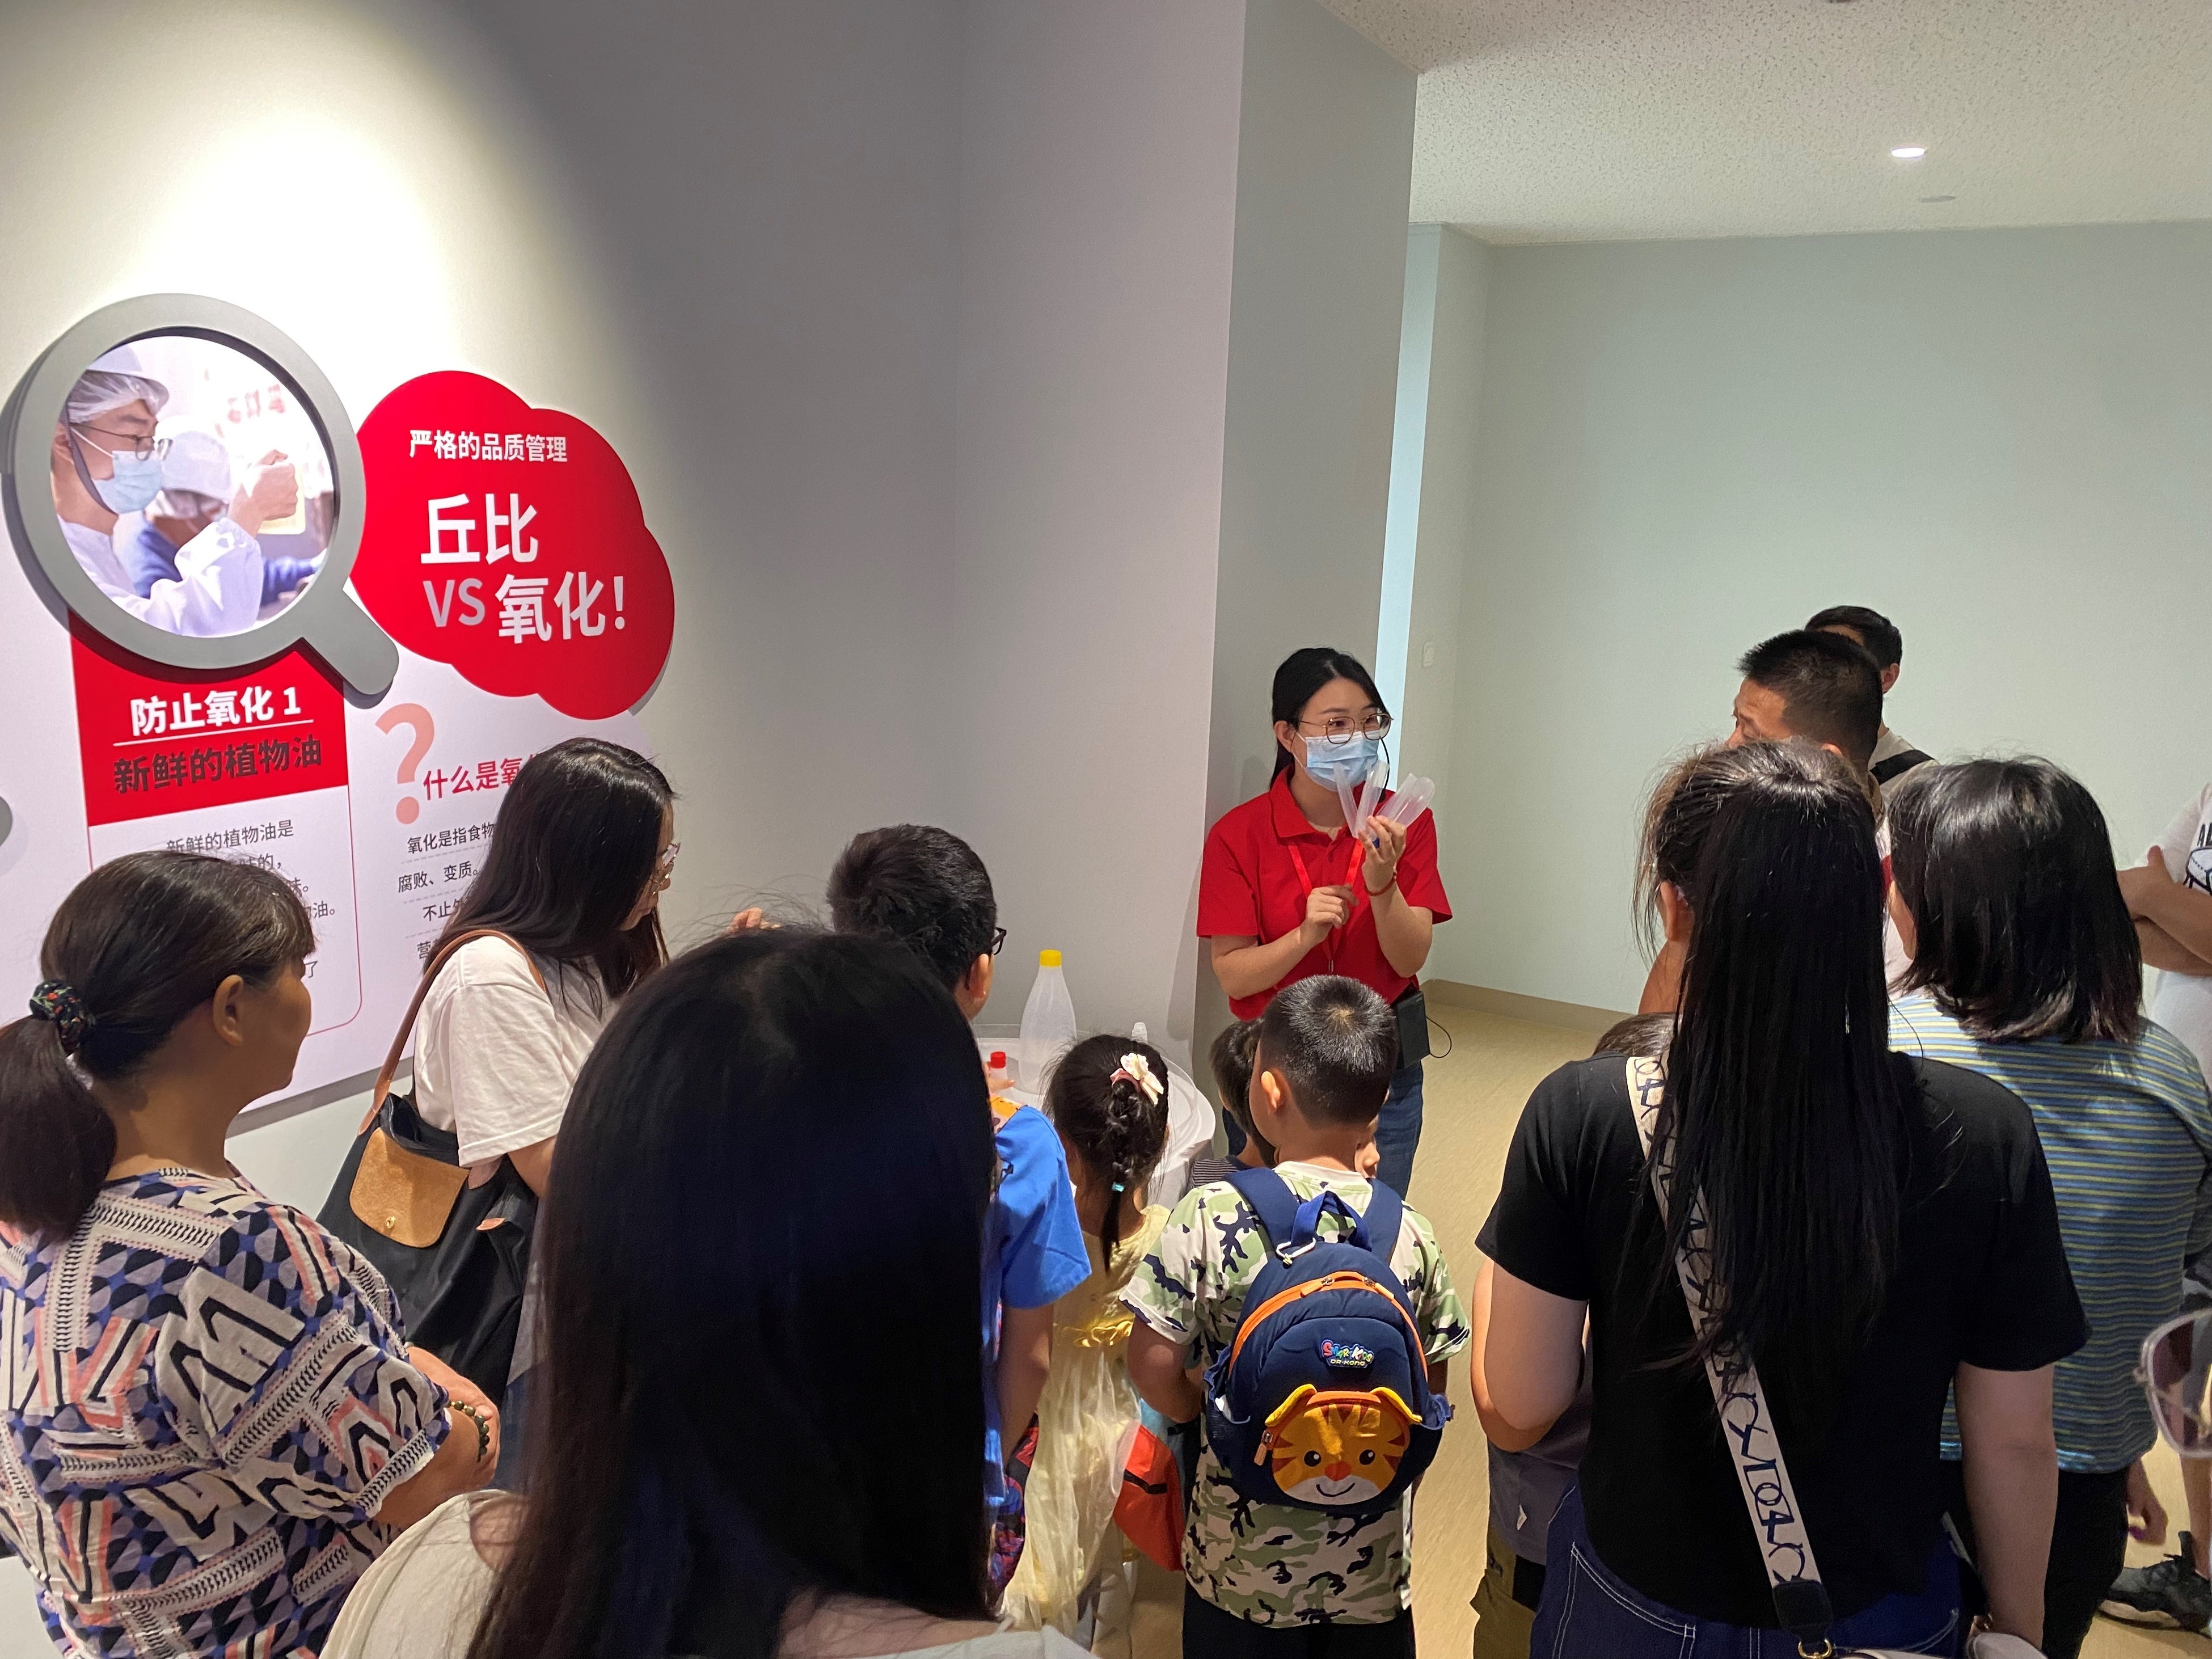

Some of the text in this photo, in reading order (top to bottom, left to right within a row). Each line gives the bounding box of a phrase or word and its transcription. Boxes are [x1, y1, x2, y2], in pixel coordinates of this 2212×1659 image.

[409, 429, 568, 462] 严格的品质管理
[420, 492, 538, 565] 丘比
[423, 577, 486, 628] VS
[130, 686, 301, 737] 防止氧化 1
[113, 734, 322, 794] 新鲜的植物油
[423, 754, 535, 801] 什么是氧
[407, 822, 494, 854] 氧化是指食物
[398, 860, 478, 893] 腐败、变质。
[423, 898, 462, 922] 不止
